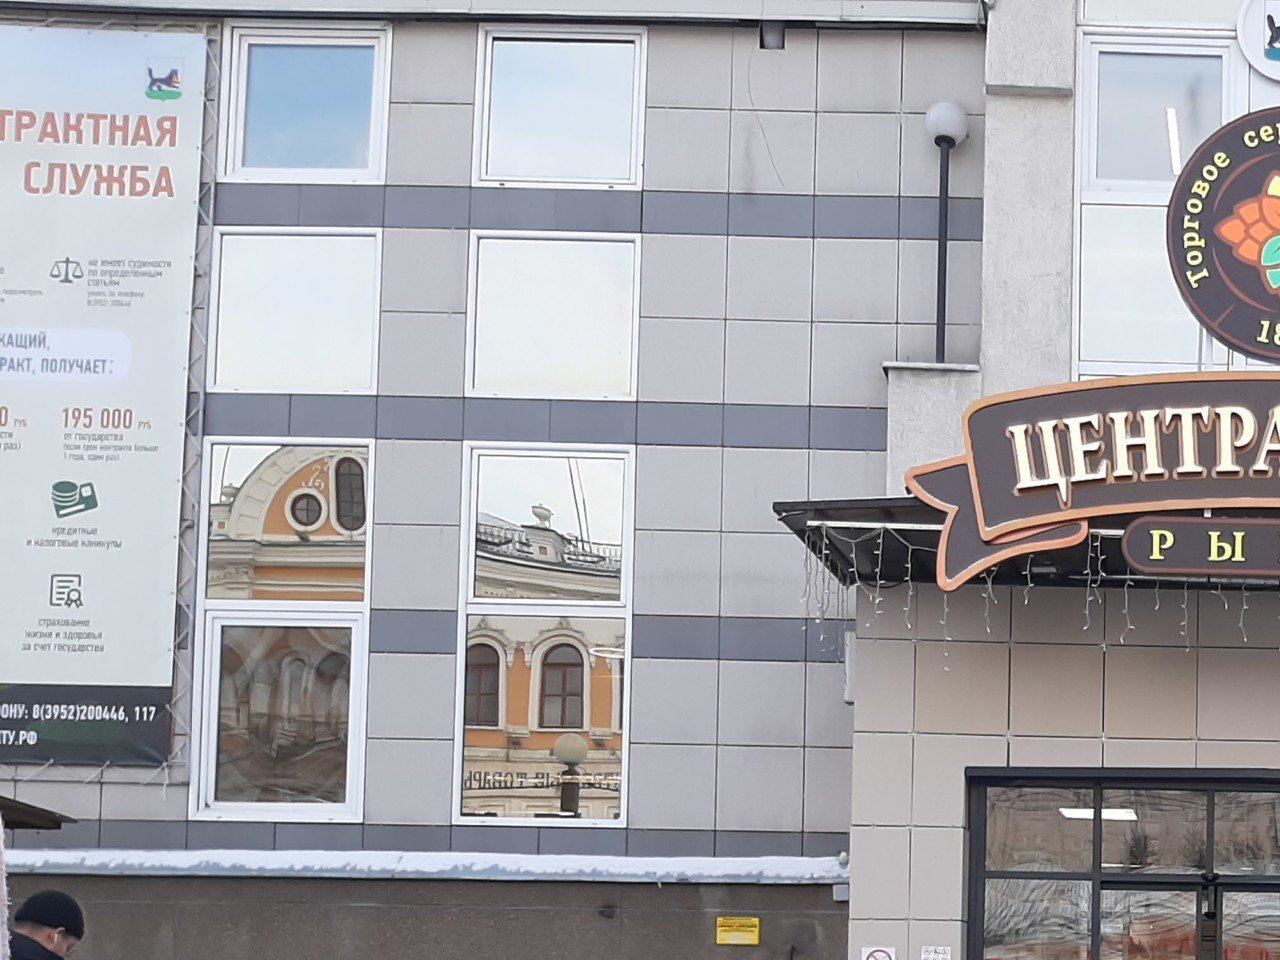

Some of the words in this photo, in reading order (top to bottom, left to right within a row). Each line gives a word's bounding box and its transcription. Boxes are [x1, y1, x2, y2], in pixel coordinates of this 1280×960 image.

[24, 161, 175, 198] СЛУЖБА
[1183, 151, 1231, 289] Торговое
[41, 357, 113, 375] ПОЛУЧАЕТ:
[62, 407, 93, 429] 195
[100, 408, 133, 429] 000
[134, 705, 156, 722] 117
